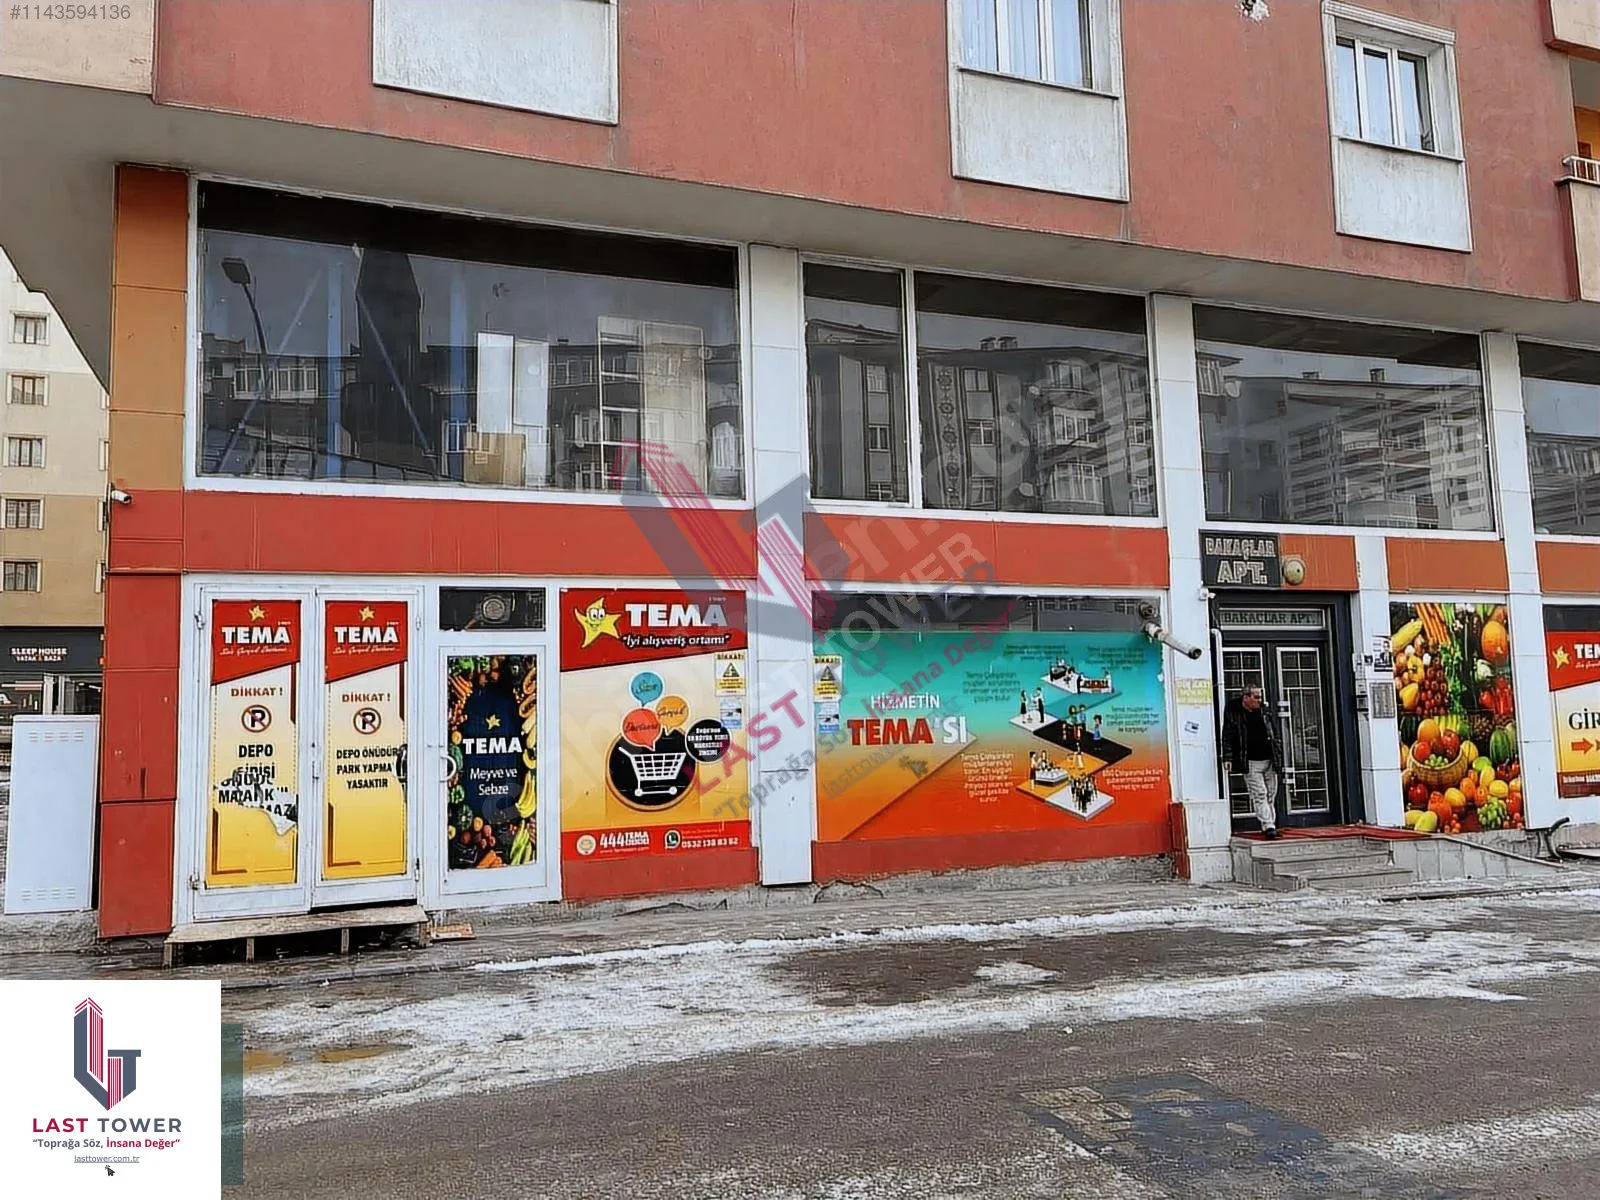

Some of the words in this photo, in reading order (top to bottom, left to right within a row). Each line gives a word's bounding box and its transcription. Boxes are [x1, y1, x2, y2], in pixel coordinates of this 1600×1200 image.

[1205, 537, 1276, 560] BAKAÇLAR
[1217, 561, 1268, 584] APT.
[625, 604, 728, 627] TEMA
[222, 627, 291, 644] TEMA
[334, 626, 399, 643] TEMA
[231, 686, 276, 697] DİKKAT
[342, 692, 384, 703] DİKKAT
[871, 692, 940, 709] HİZMETİN
[238, 744, 274, 758] DEPO
[336, 748, 360, 759] DEPO
[463, 737, 522, 755] TEMA
[336, 764, 361, 775] PARK
[470, 768, 504, 781] Meyve
[506, 768, 518, 777] ve
[346, 778, 388, 790] YASAKTIR
[478, 783, 509, 796] Sebze
[600, 832, 625, 848] 444
